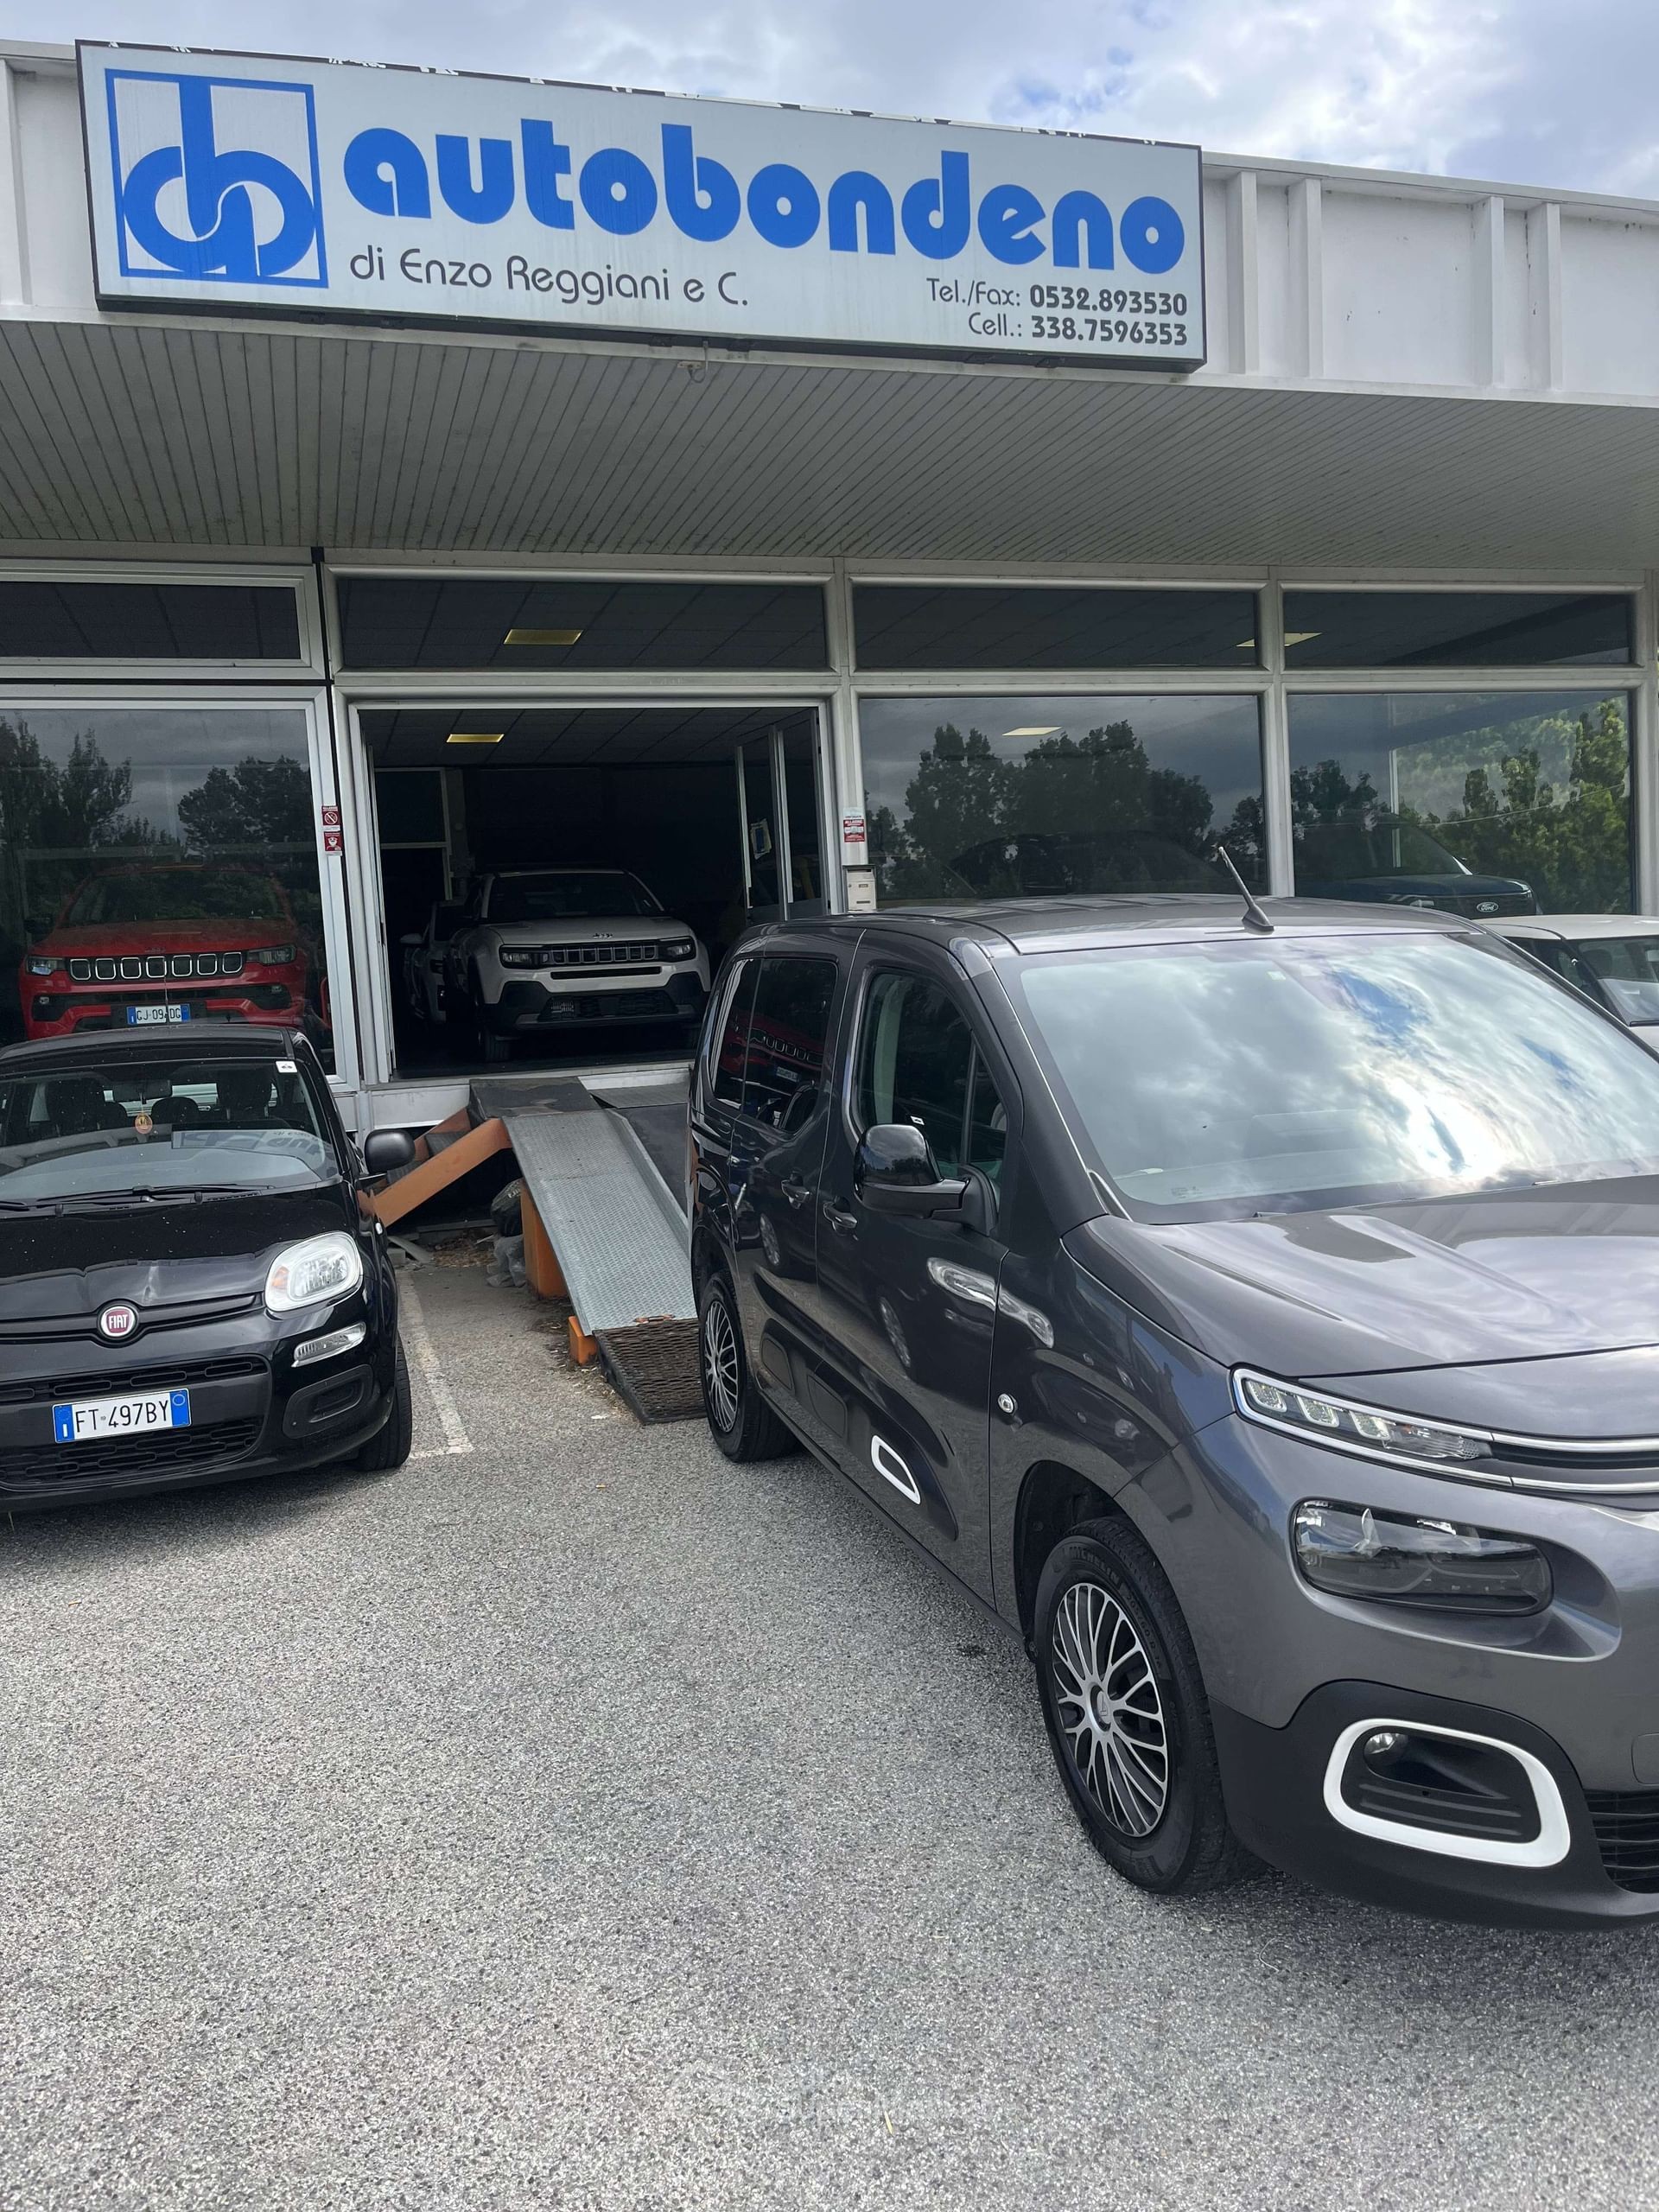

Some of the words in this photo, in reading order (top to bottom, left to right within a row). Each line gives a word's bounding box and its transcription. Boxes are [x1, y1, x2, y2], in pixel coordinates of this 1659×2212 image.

[344, 118, 1185, 275] autobondeno
[350, 245, 385, 281] di
[400, 248, 493, 288] Enzo
[506, 255, 670, 306] Reggiani
[683, 277, 705, 303] e
[718, 271, 748, 306] C.
[926, 277, 1020, 307] Tel./Fax:
[1030, 284, 1188, 316] 0532.893530
[969, 312, 1022, 337] Cell.:
[1031, 315, 1188, 346] 338.7596353
[108, 1313, 128, 1329] FIAT
[108, 1399, 168, 1428] 497BY
